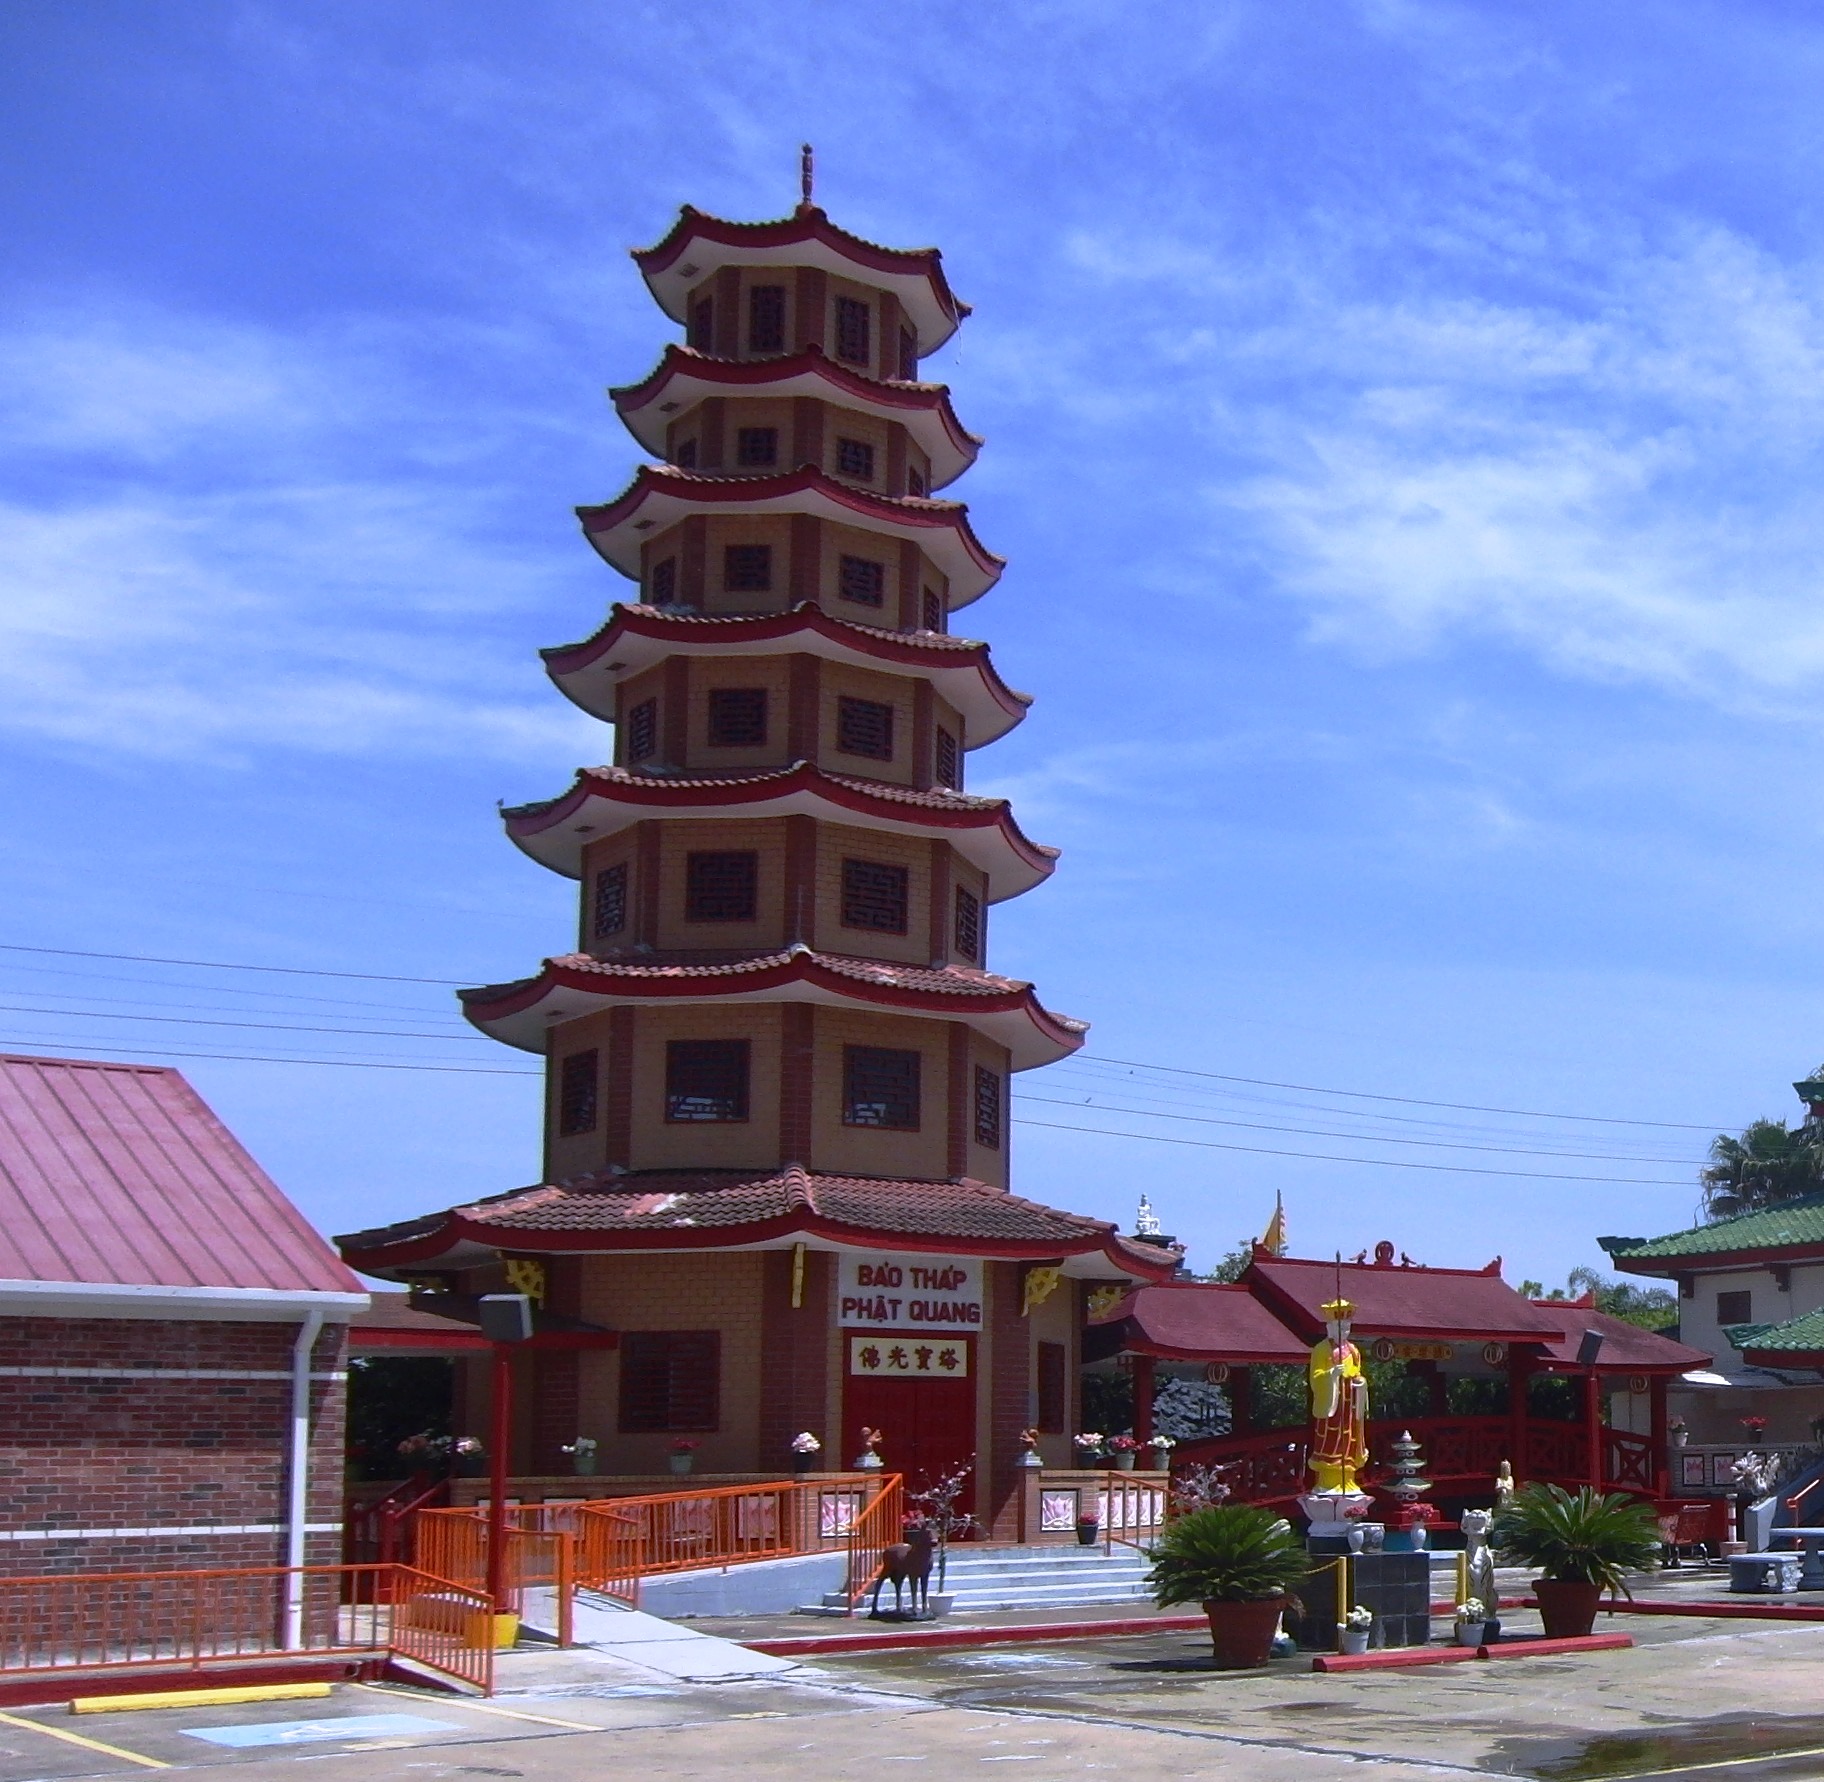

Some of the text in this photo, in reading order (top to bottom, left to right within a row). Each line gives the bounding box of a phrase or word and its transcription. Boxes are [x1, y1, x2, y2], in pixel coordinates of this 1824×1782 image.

[909, 1265, 967, 1290] THÁP
[842, 1295, 980, 1323] PHẬT QUANG
